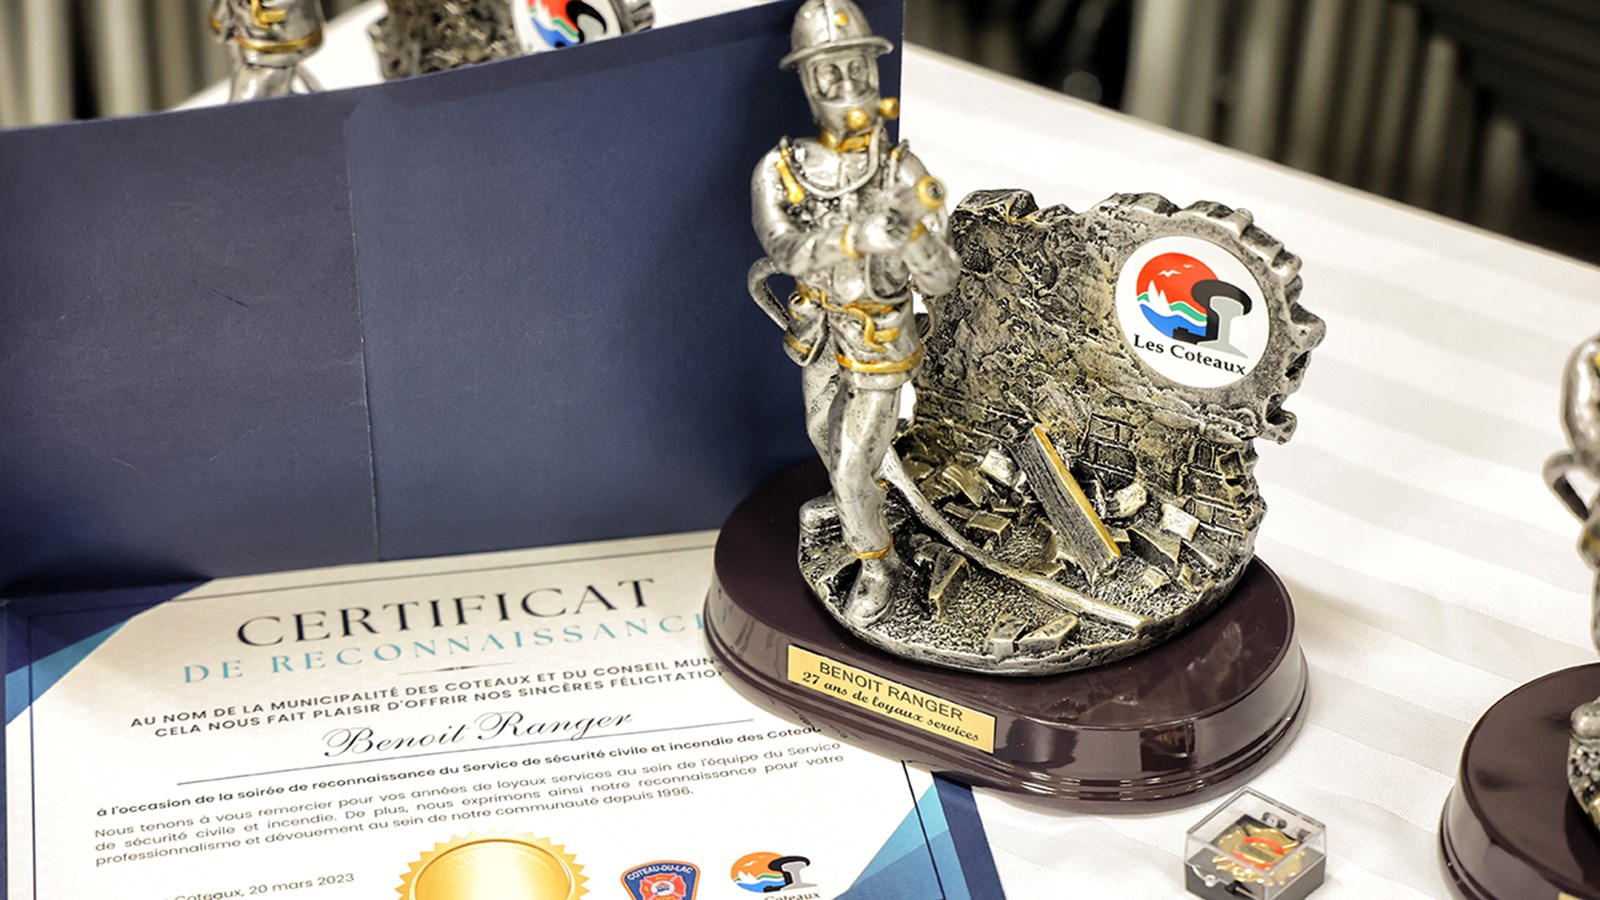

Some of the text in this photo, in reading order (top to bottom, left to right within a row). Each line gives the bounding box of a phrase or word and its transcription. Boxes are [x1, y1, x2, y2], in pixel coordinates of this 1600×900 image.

[1134, 334, 1246, 375] Les Coteaux
[237, 578, 654, 646] CERTIFICAT
[131, 717, 155, 727] AU
[164, 711, 206, 723] NOM
[214, 707, 235, 717] DE
[243, 704, 263, 713] LA
[271, 687, 398, 710] MUNICIPALITÉ
[406, 685, 438, 695] DES
[445, 675, 530, 691] COTEAUX
[537, 673, 555, 682] ET
[563, 670, 586, 679] DU
[593, 662, 668, 676] CONSEIL
[155, 669, 722, 737] CELA NOUS FAIT PLAISIR D'OFFRIR NOS SINCÈRES FÉLICITATIO
[184, 660, 243, 683] DE
[819, 661, 964, 721] BENOIT RANGER
[322, 711, 632, 757] Benoit Ranger
[802, 671, 979, 742] 27 ans de loyaux services
[95, 827, 134, 837] Nous
[140, 820, 194, 834] tenons
[200, 816, 210, 824] à
[216, 812, 252, 822] vous
[259, 801, 332, 816] remercier
[339, 797, 373, 812] pour
[379, 793, 405, 801] vos
[411, 786, 467, 798] années
[473, 783, 491, 791] de
[497, 778, 546, 789] loyaux
[552, 771, 612, 783] services
[642, 764, 672, 773] sein
[701, 755, 758, 766] l'équipe
[788, 744, 840, 755] Service
[95, 756, 843, 851] de sécurité civile et incendie. De plus, nous exprimons ainsi notre reconnaissance pour votre
[112, 799, 190, 815] l'occasion
[195, 796, 214, 804] de
[219, 793, 233, 801] la
[238, 787, 284, 798] soirée
[289, 784, 308, 792] de
[313, 770, 435, 789] reconnaissance
[463, 761, 518, 772] Service
[522, 758, 540, 766] de
[545, 750, 605, 763] sécurité
[609, 747, 647, 757] civile
[670, 737, 733, 750] incendie
[96, 840, 241, 867] professionnalisme
[265, 824, 363, 842] dévouement
[393, 817, 423, 826] sein
[428, 814, 447, 822] de
[452, 810, 491, 820] notre
[495, 798, 599, 815] communauté
[603, 792, 653, 804] depuis
[658, 787, 693, 797] 1996.
[249, 885, 267, 895] 20
[273, 880, 313, 891] mars
[318, 873, 354, 885] 2023
